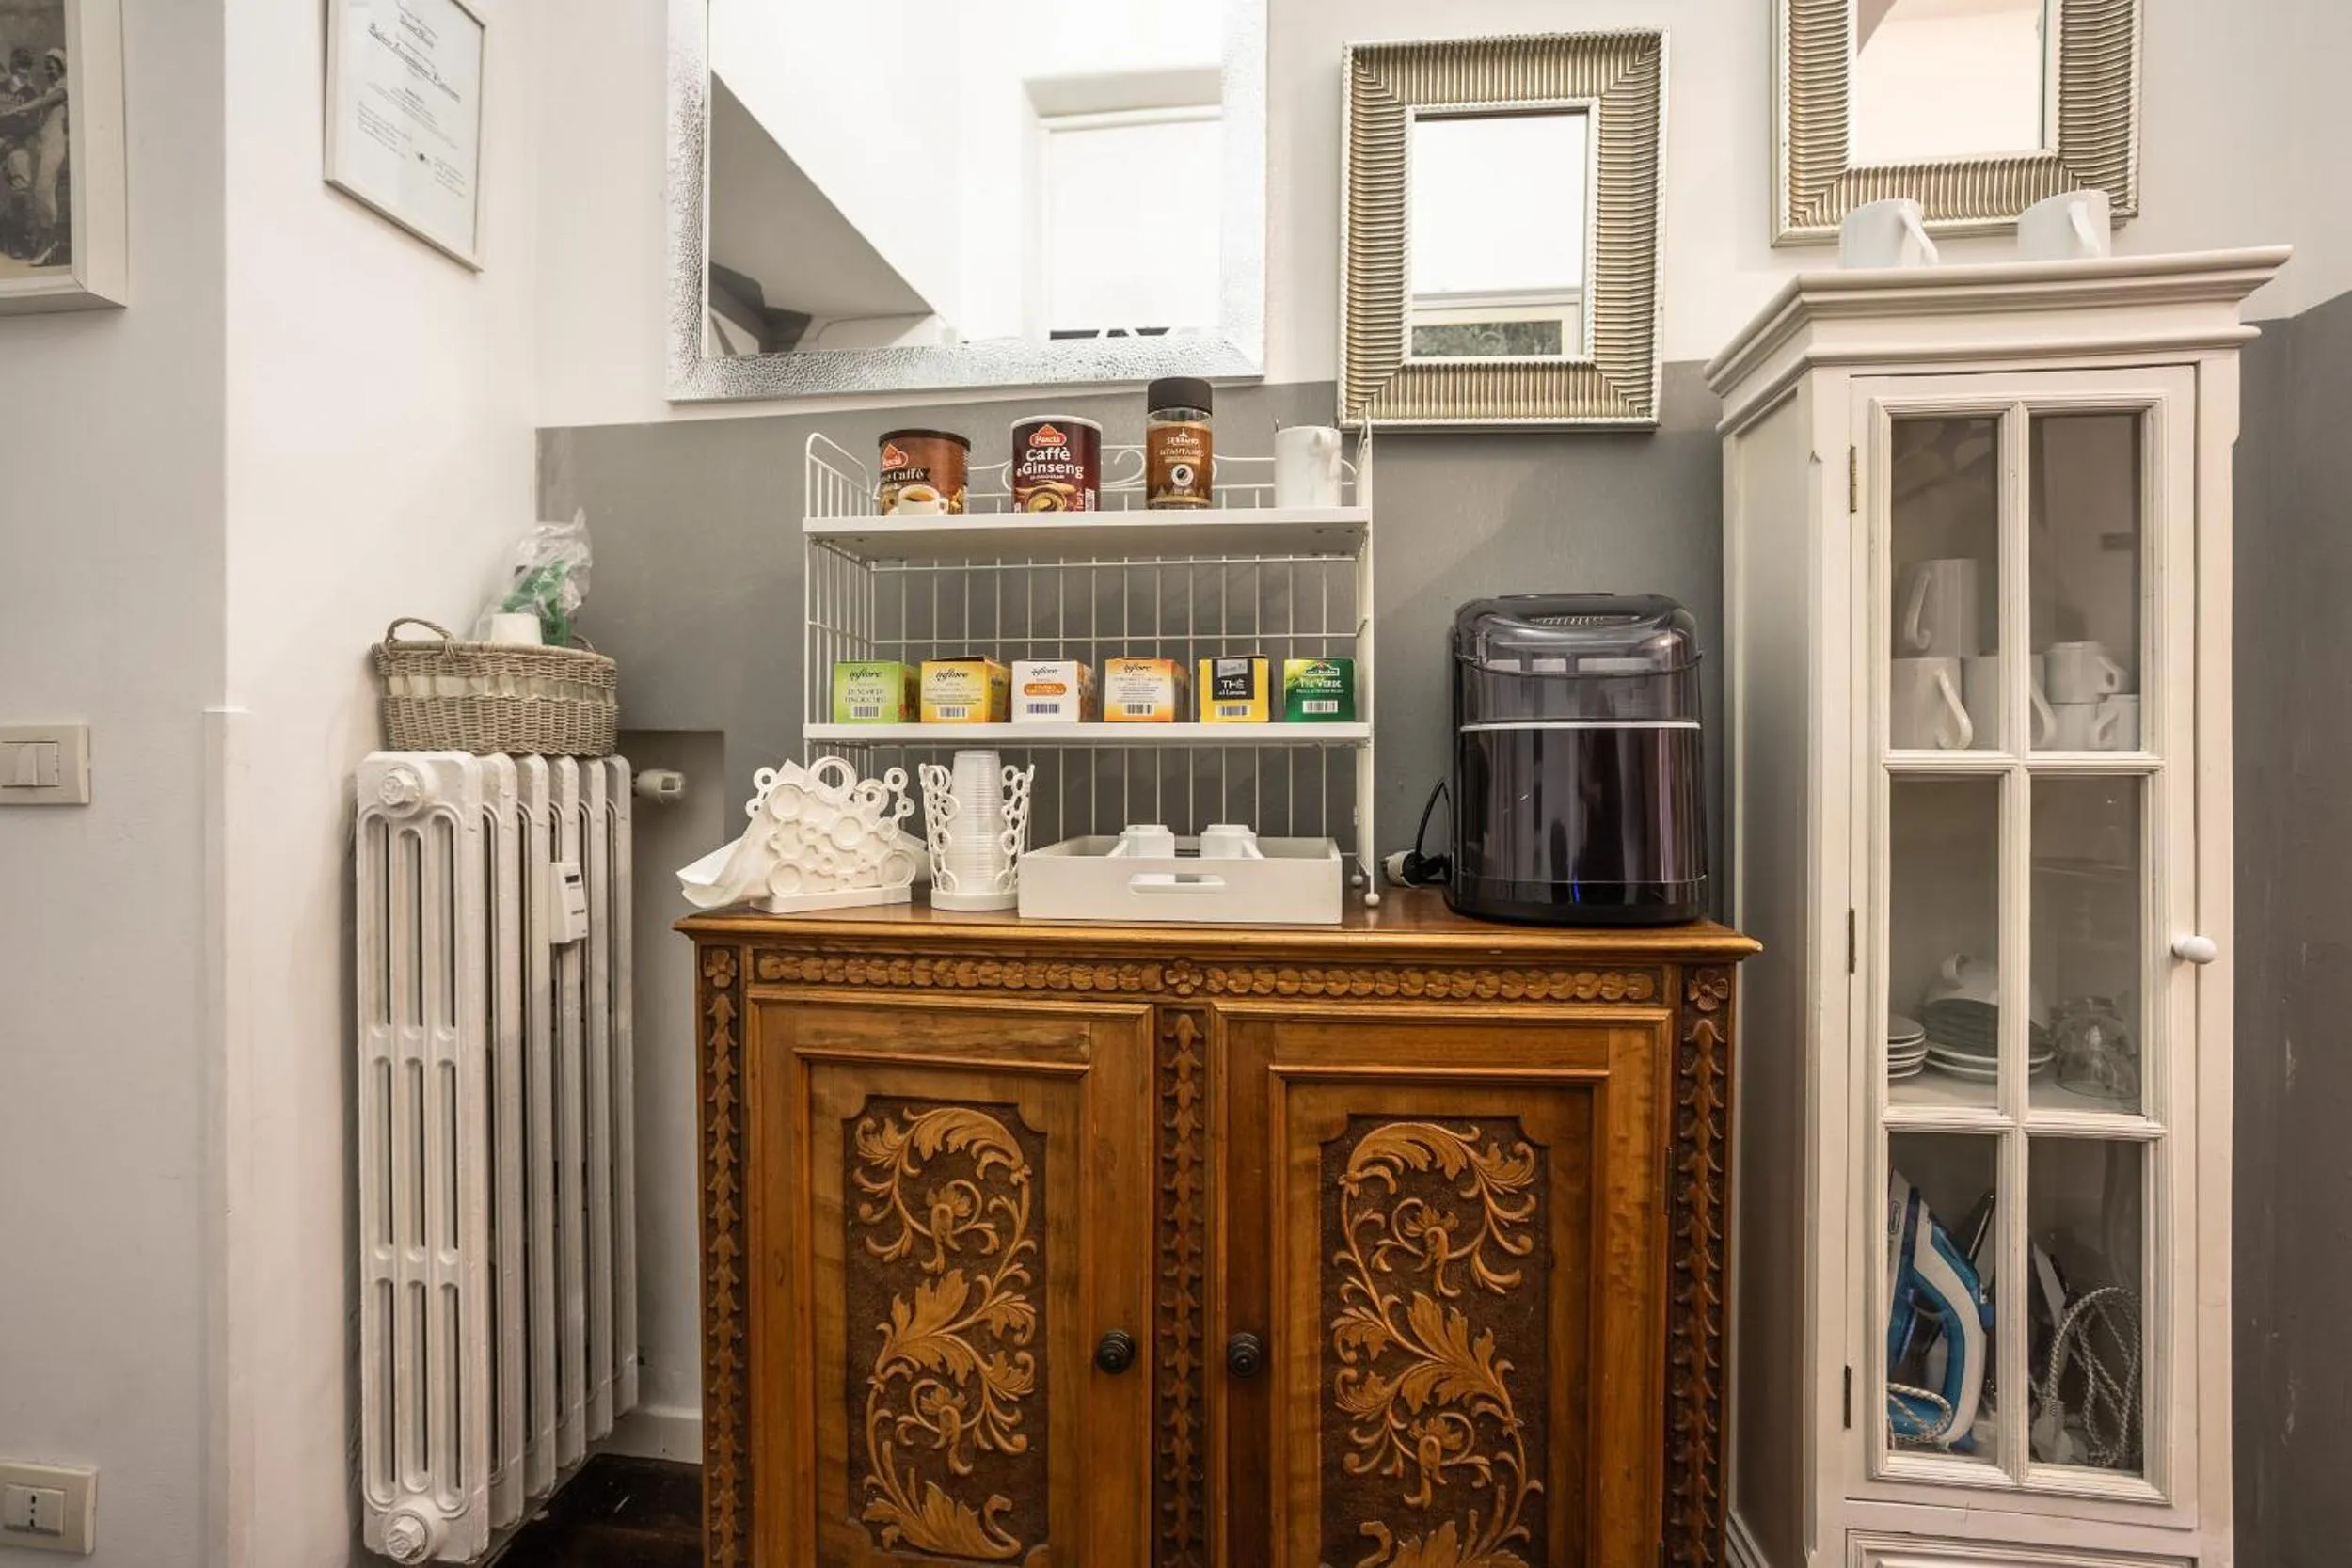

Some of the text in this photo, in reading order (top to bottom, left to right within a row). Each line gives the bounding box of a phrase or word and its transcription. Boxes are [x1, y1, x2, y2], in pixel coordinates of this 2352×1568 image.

[1025, 446, 1071, 462] Caffè
[892, 467, 925, 481] Caffè
[1022, 461, 1085, 480] Ginseng
